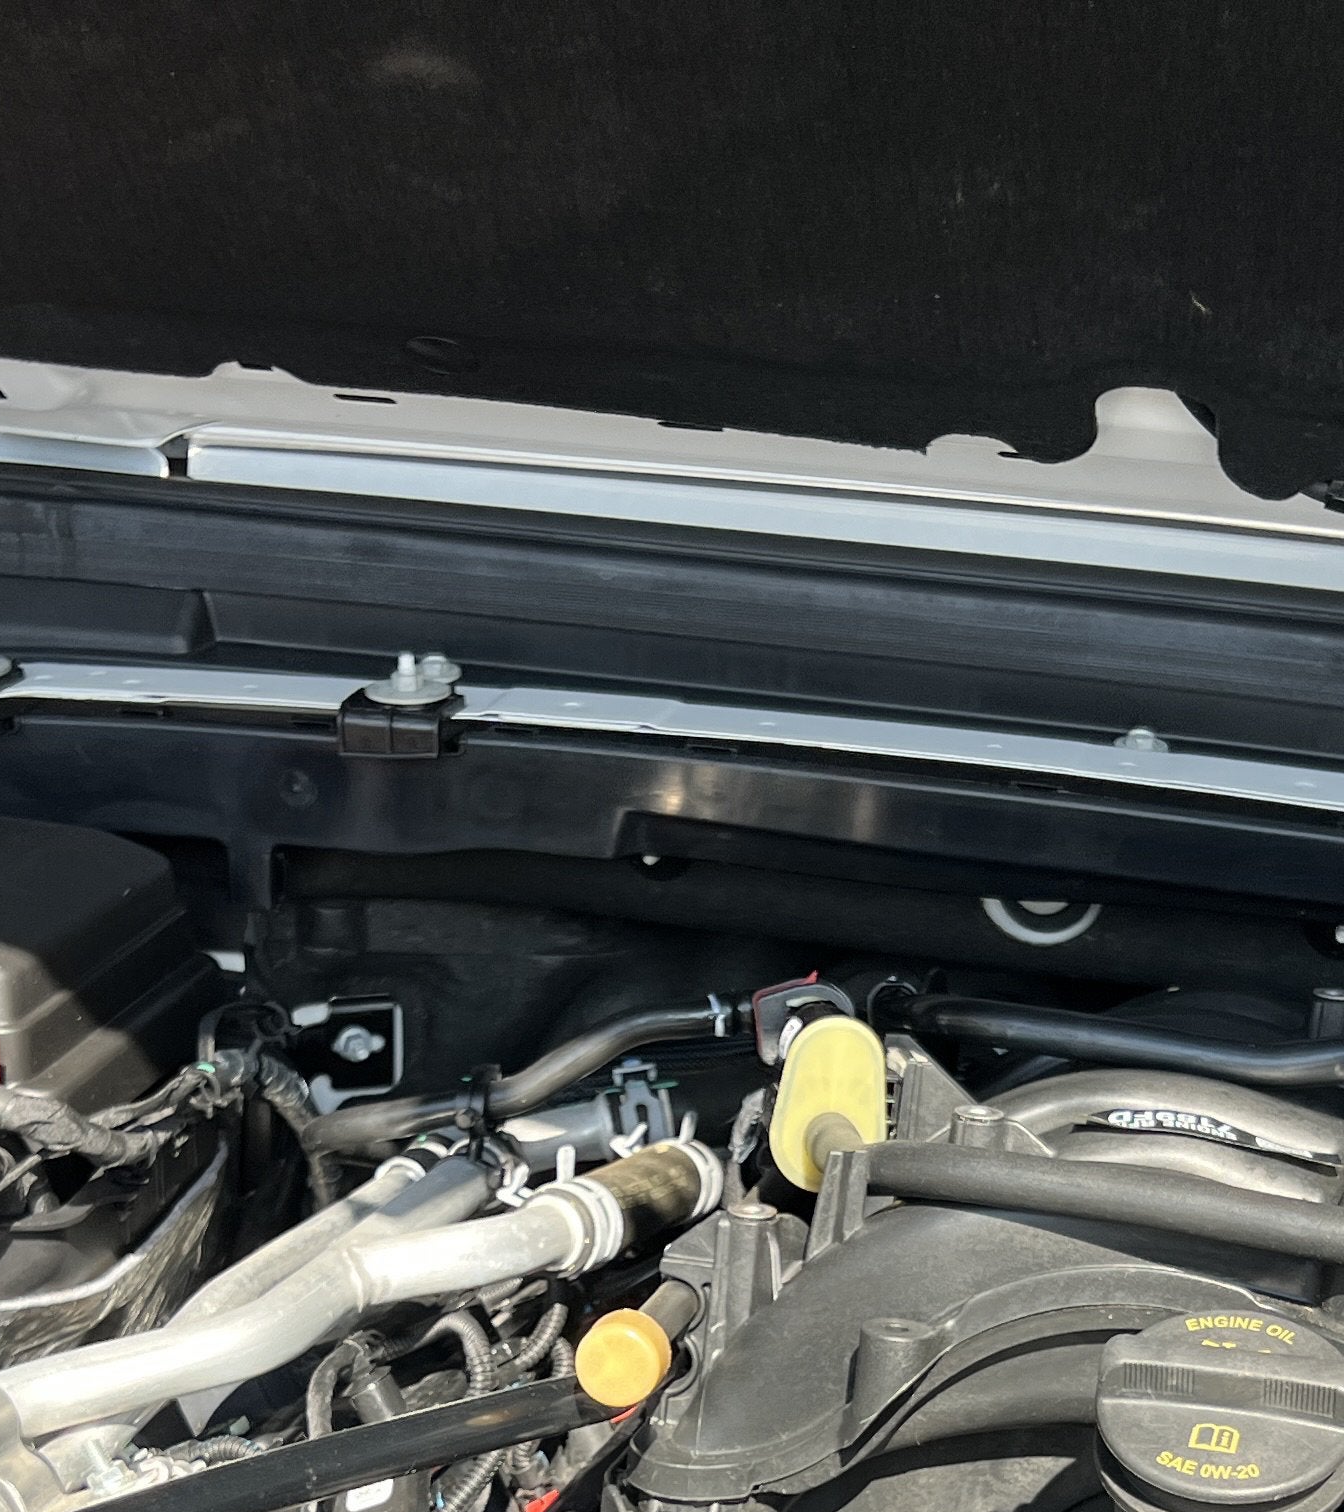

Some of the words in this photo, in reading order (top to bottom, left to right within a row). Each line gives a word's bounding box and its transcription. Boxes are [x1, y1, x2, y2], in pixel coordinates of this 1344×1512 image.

[1184, 1315, 1264, 1332] ENGINE
[1265, 1324, 1296, 1345] OIL
[1155, 1450, 1198, 1475] SAE
[1199, 1463, 1260, 1480] 0W-20
